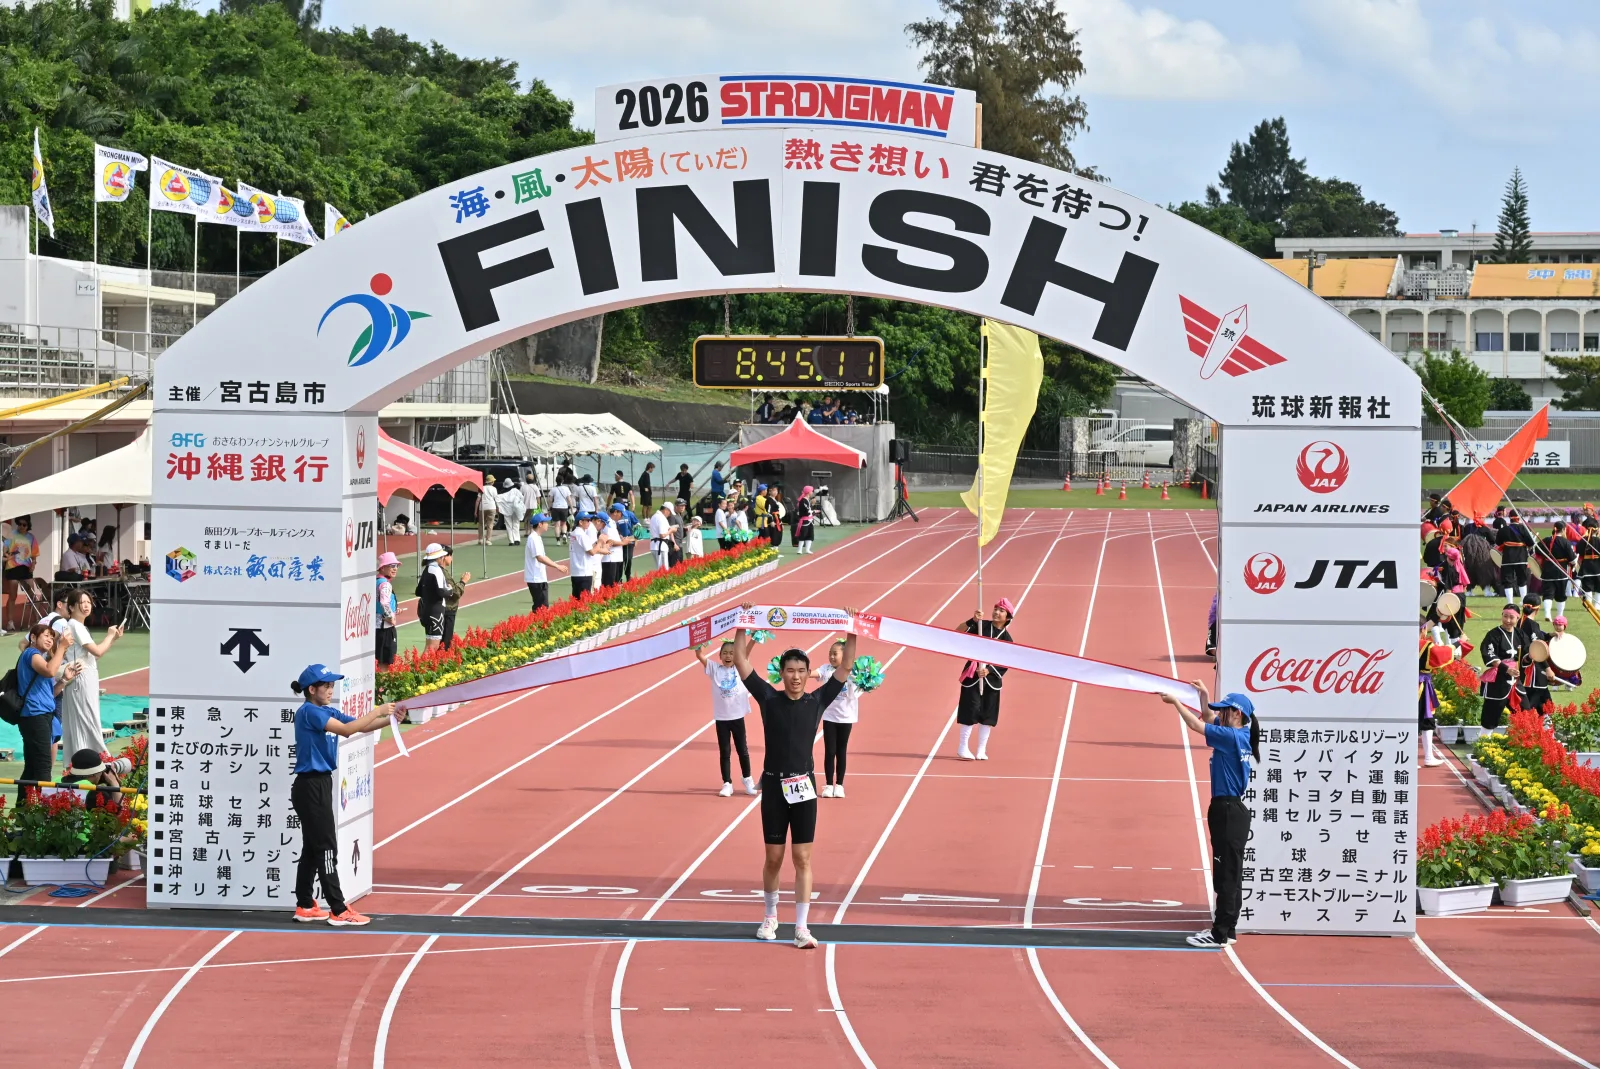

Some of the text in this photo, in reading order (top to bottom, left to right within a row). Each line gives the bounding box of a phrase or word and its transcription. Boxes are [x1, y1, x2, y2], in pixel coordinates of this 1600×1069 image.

[615, 81, 954, 131] 2026 STRONGMAN
[784, 138, 950, 179] 熱き想い
[968, 161, 1149, 242] 君を待つ!
[437, 178, 1160, 352] FINISH
[78, 284, 95, 292] トイレ
[1252, 395, 1391, 419] 琉球新報社
[212, 436, 330, 448] おきなわフィナンシャルグループ
[166, 452, 330, 483] 沖縄銀行
[1310, 478, 1339, 487] JAL
[1254, 503, 1390, 513] JAPAN AIRLINES
[204, 526, 315, 538] 飯田グループホールディングス
[354, 520, 373, 551] JTA
[204, 540, 251, 551] すまいーだ
[203, 554, 325, 581] 株式会社 飯田産業
[1294, 559, 1398, 589] JTA
[1254, 582, 1278, 590] JAL
[739, 614, 756, 624] 完走
[792, 611, 849, 619] CONGRATULATIONS
[1244, 647, 1394, 694] Coca-Cola
[170, 742, 259, 758] たびのホテル
[266, 744, 281, 758] lit
[1250, 748, 1410, 765] ミノバイタル
[789, 781, 809, 795] 1454
[1242, 788, 1409, 805] 沖縄トヨタ自動車
[169, 812, 301, 829] 沖縄海邦銀
[169, 829, 293, 846] 宮古テレ
[1242, 847, 1408, 865] 琉球銀行
[1241, 867, 1408, 884] 宮古空港ターミナル
[168, 882, 326, 901] オリオンビル
[1241, 887, 1408, 904] フォーモストブルーシール
[1240, 907, 1407, 923] キャステム
